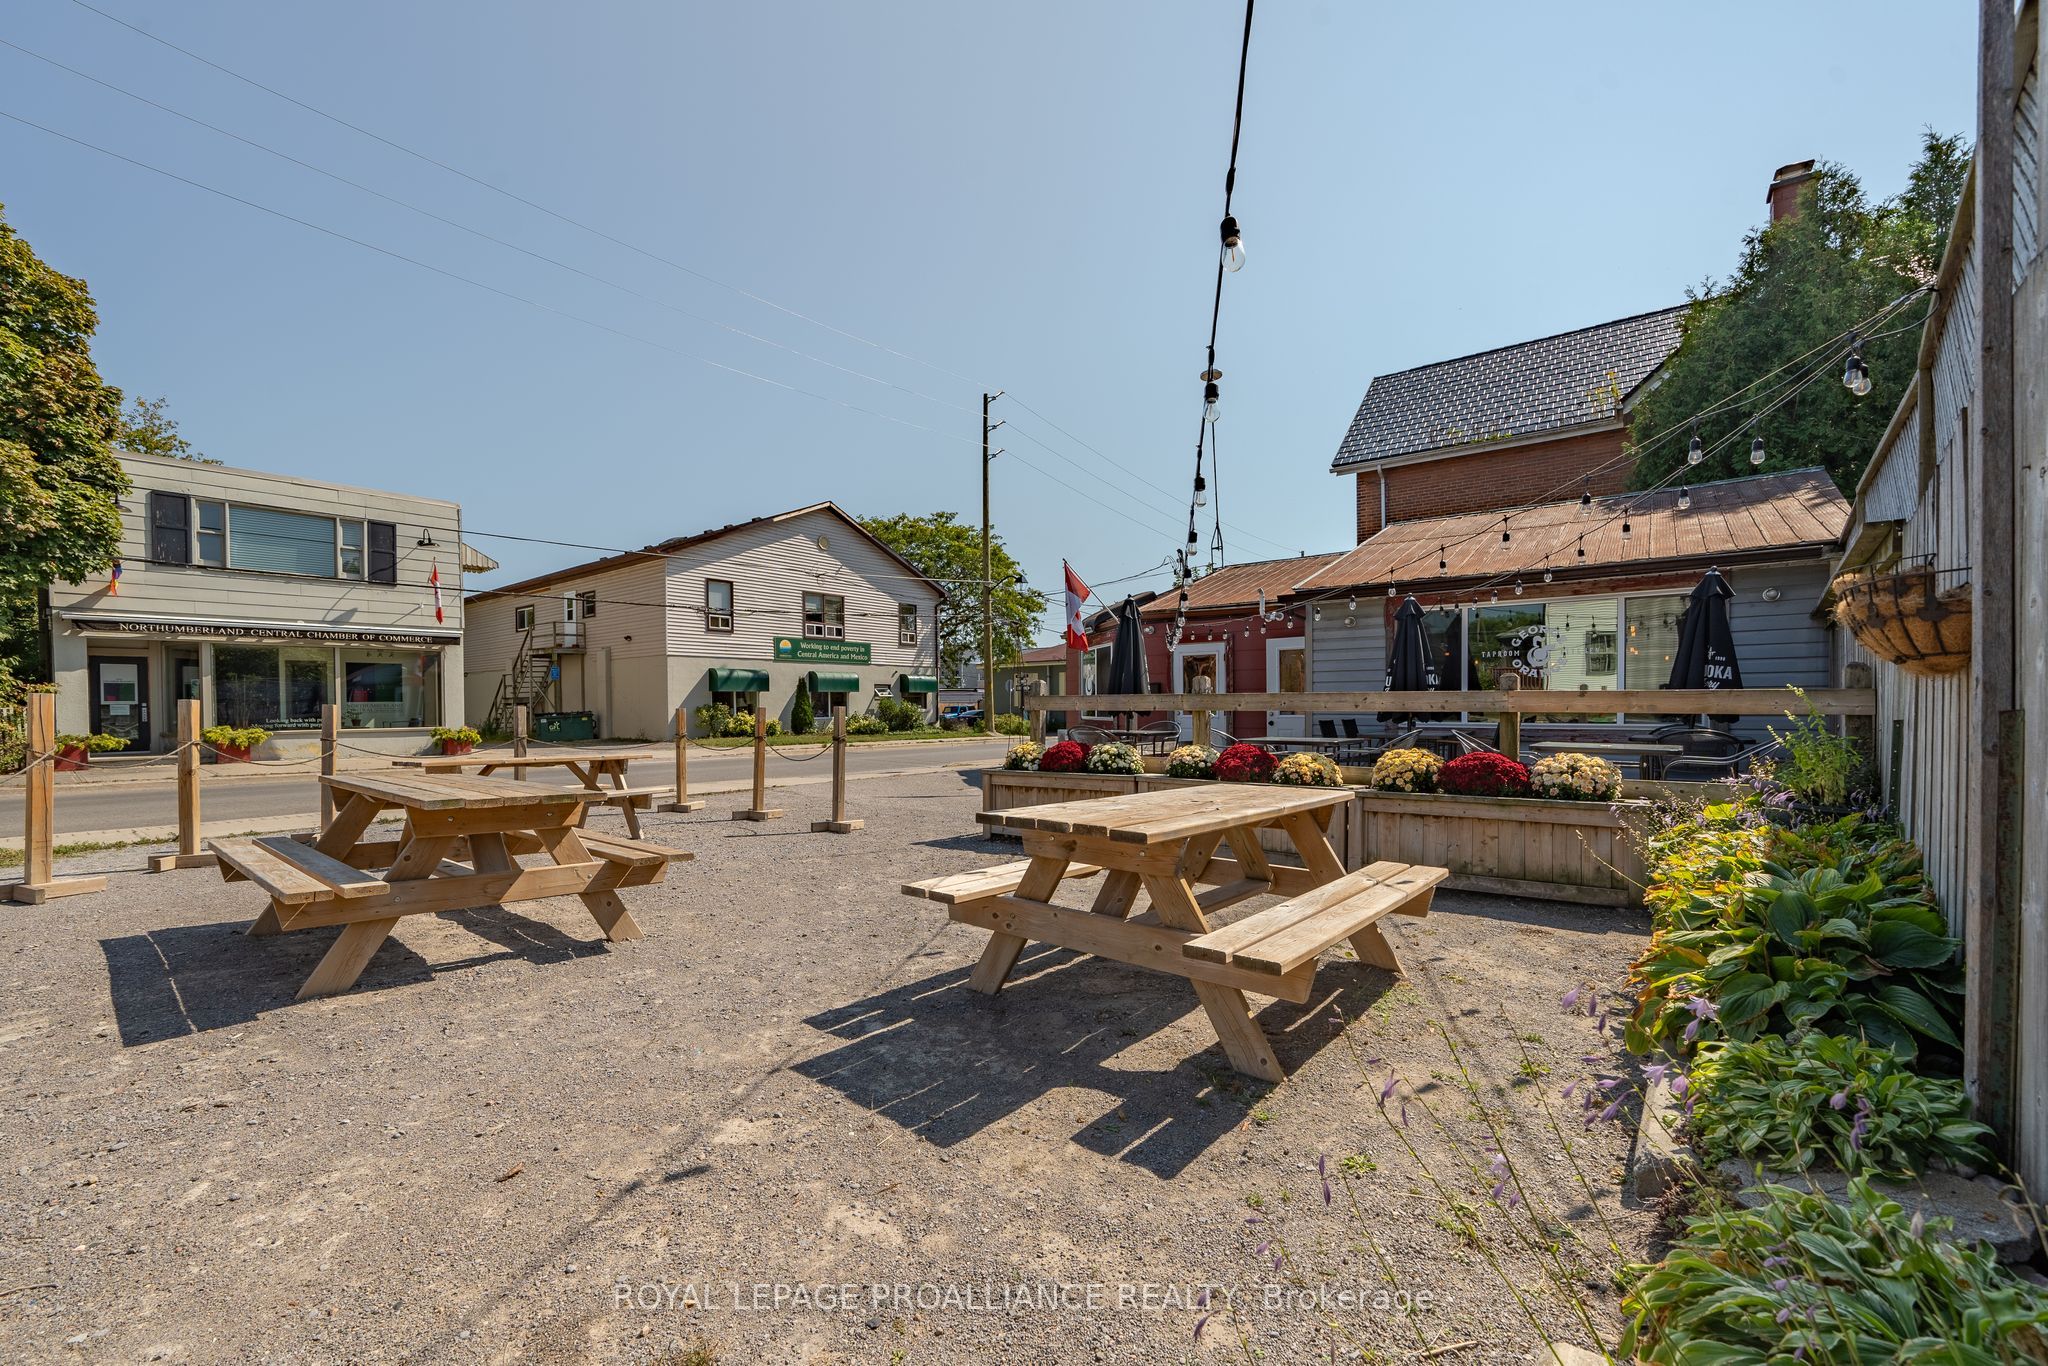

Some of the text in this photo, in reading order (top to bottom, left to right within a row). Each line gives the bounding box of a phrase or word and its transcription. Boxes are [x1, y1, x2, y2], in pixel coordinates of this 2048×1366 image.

[119, 622, 433, 644] NORTHUMBERLAND CENTRAL CHAMBER OF COMMERCE
[800, 642, 822, 651] Working
[818, 651, 839, 659] America
[840, 652, 849, 660] and
[850, 653, 868, 661] Mexico
[1481, 650, 1520, 658] TAPROOM
[1704, 664, 1733, 680] OKA
